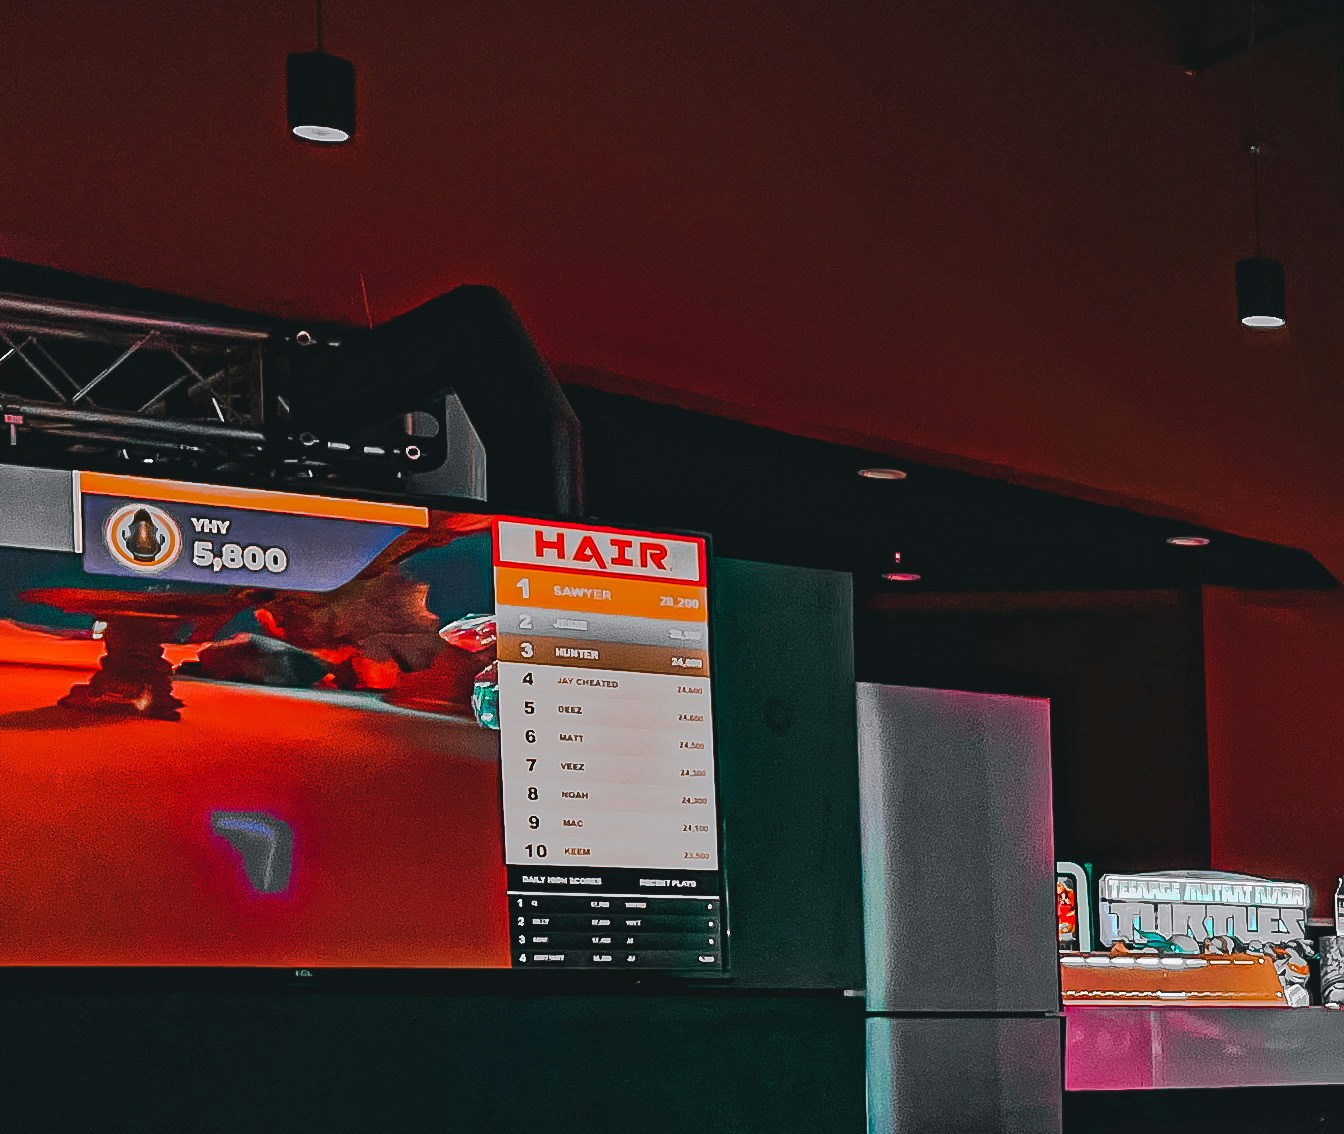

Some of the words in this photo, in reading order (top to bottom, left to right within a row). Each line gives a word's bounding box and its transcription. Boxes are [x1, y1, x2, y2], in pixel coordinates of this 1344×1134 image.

[190, 517, 230, 535] YHY
[193, 540, 288, 573] 5,800
[535, 530, 668, 570] HAIR
[516, 578, 530, 599] 1
[553, 585, 612, 601] SAWYER
[519, 614, 533, 630] 2
[520, 642, 534, 658] 3
[555, 647, 599, 660] HUNTER
[522, 672, 534, 686] 4
[576, 678, 619, 689] CHEATED
[524, 701, 535, 715] 5
[525, 729, 537, 744] 6
[559, 733, 584, 743] MATT
[525, 758, 537, 772] 7
[527, 786, 539, 801] 8
[561, 790, 589, 800] NOAH
[528, 815, 540, 829] 9
[562, 819, 584, 828] MAC
[524, 844, 548, 859] 10
[1107, 902, 1306, 946] TURTLES
